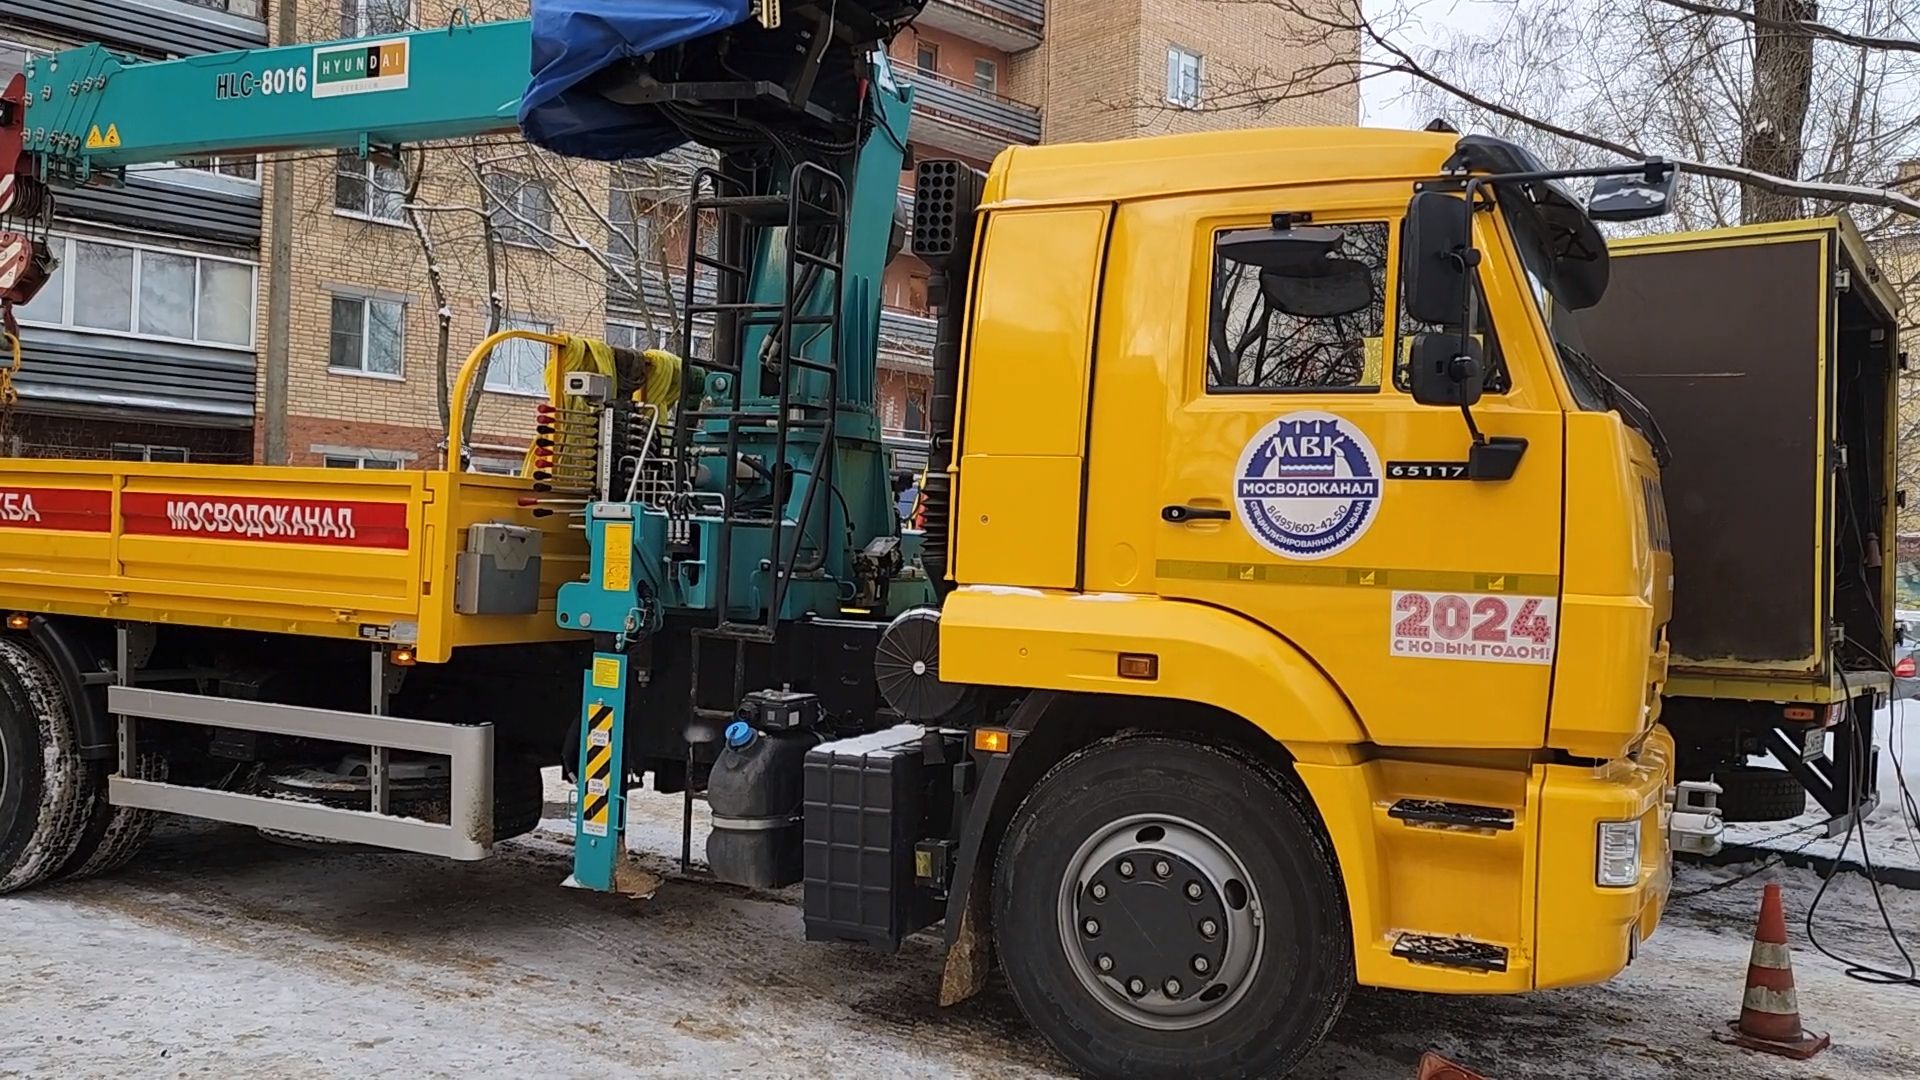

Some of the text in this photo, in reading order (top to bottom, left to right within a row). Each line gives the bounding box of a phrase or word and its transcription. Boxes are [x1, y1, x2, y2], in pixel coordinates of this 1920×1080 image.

[322, 52, 399, 75] HYUNDAI
[216, 66, 307, 99] HLC-8016
[1265, 436, 1346, 457] МВК
[1392, 466, 1464, 477] 65117
[1243, 482, 1374, 496] МОСВОДОКАНАЛ
[167, 501, 355, 538] МОСВОДОКАНАЛ
[1250, 500, 1365, 548] СПЕЦИАЛИЗИРОВАННАЯ АВТОБАЗА
[1266, 504, 1348, 534] 8(495)602-42-50
[1394, 593, 1552, 646] 2024
[1394, 640, 1550, 660] С НОВЫМ ГОДОМ!
